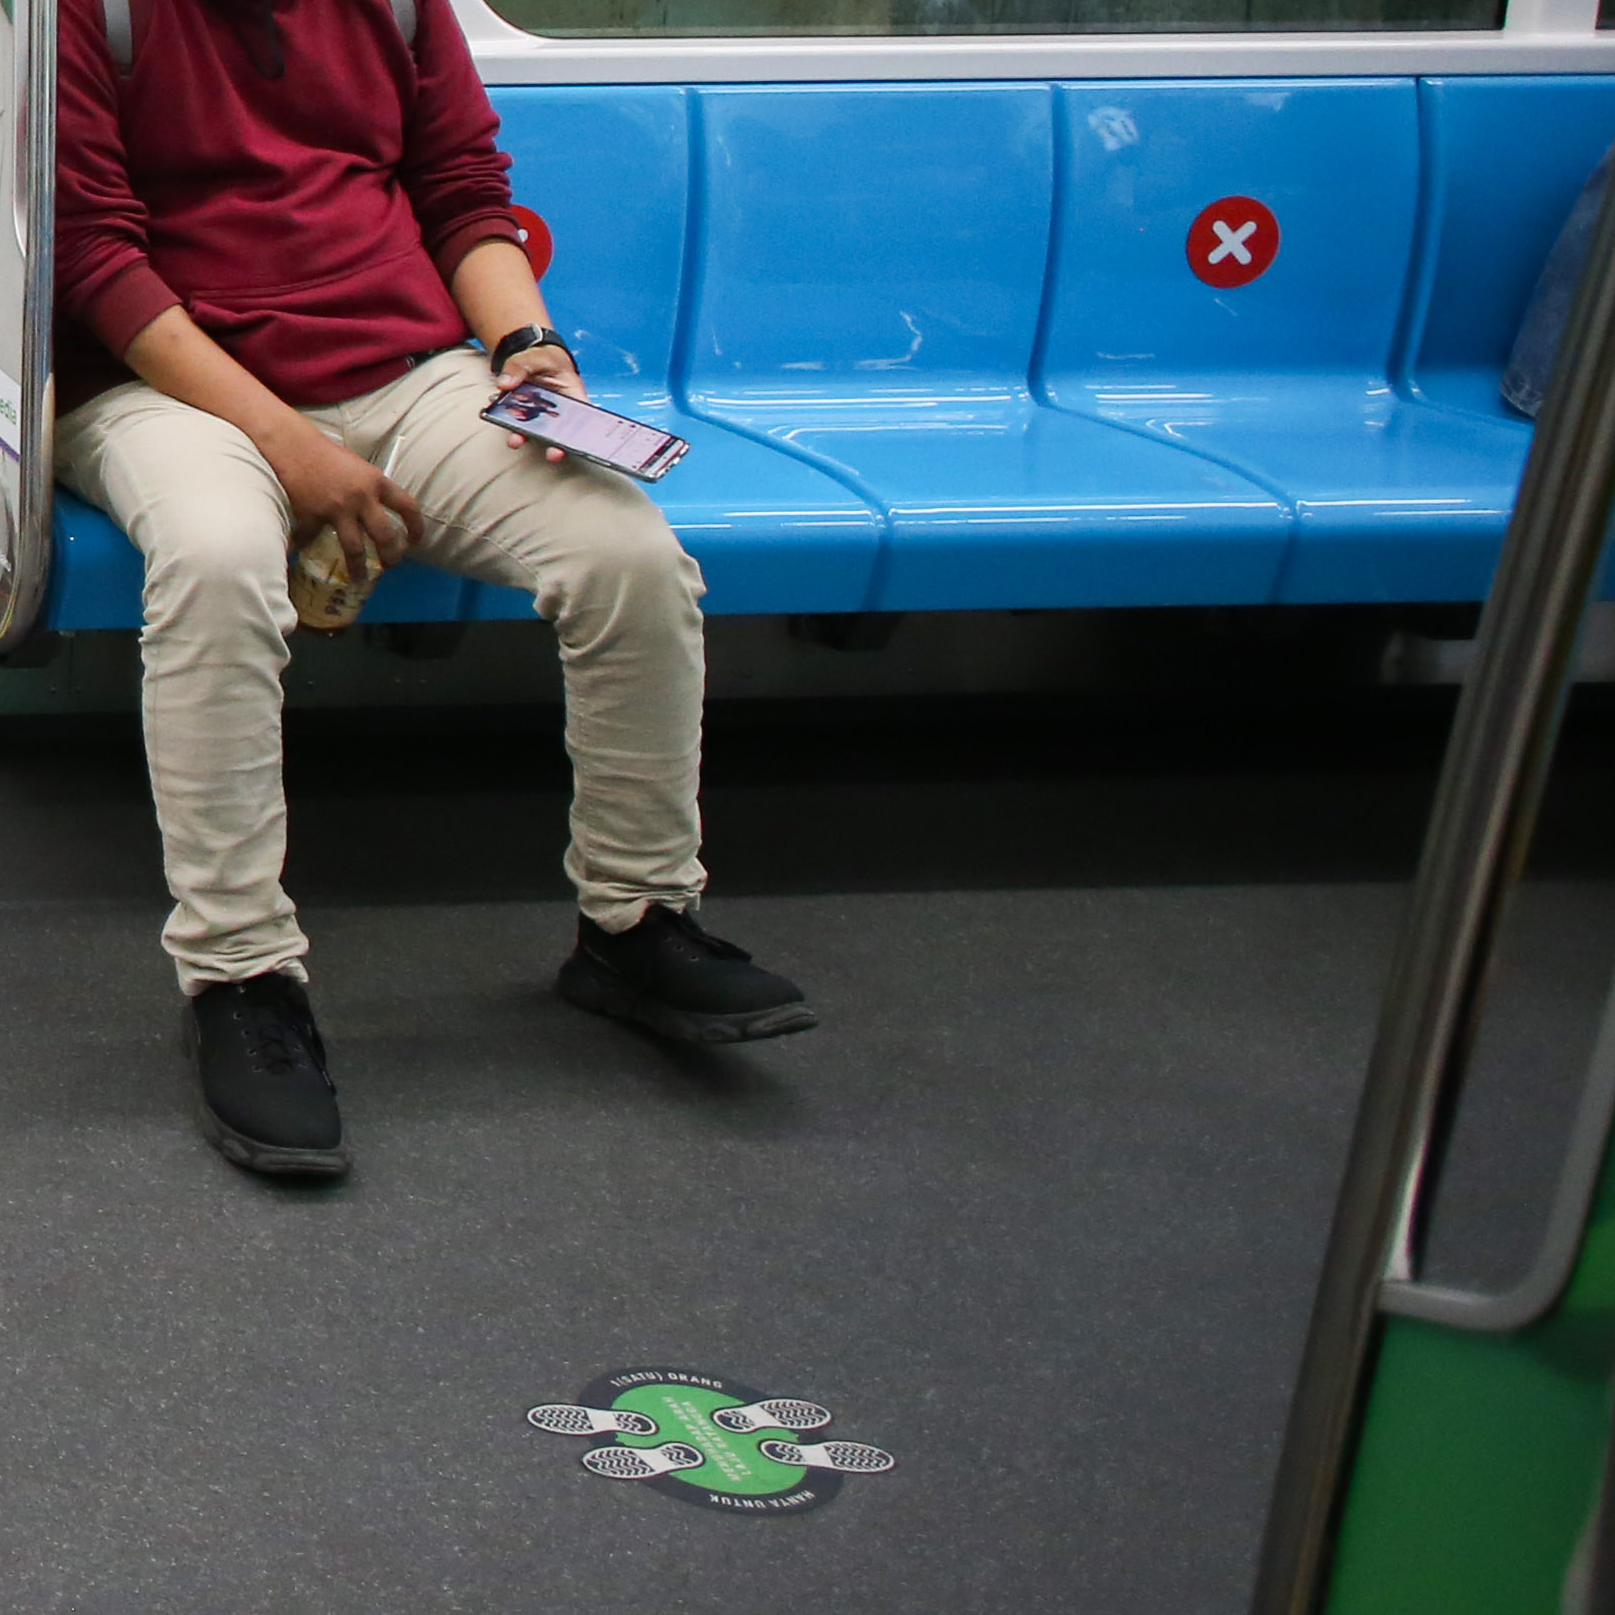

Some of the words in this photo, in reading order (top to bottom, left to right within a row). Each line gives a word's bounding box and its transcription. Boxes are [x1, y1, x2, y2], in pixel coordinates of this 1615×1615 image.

[667, 1372, 723, 1388] ORANG
[709, 1493, 767, 1509] UNTUK
[770, 1490, 816, 1509] HANYA
